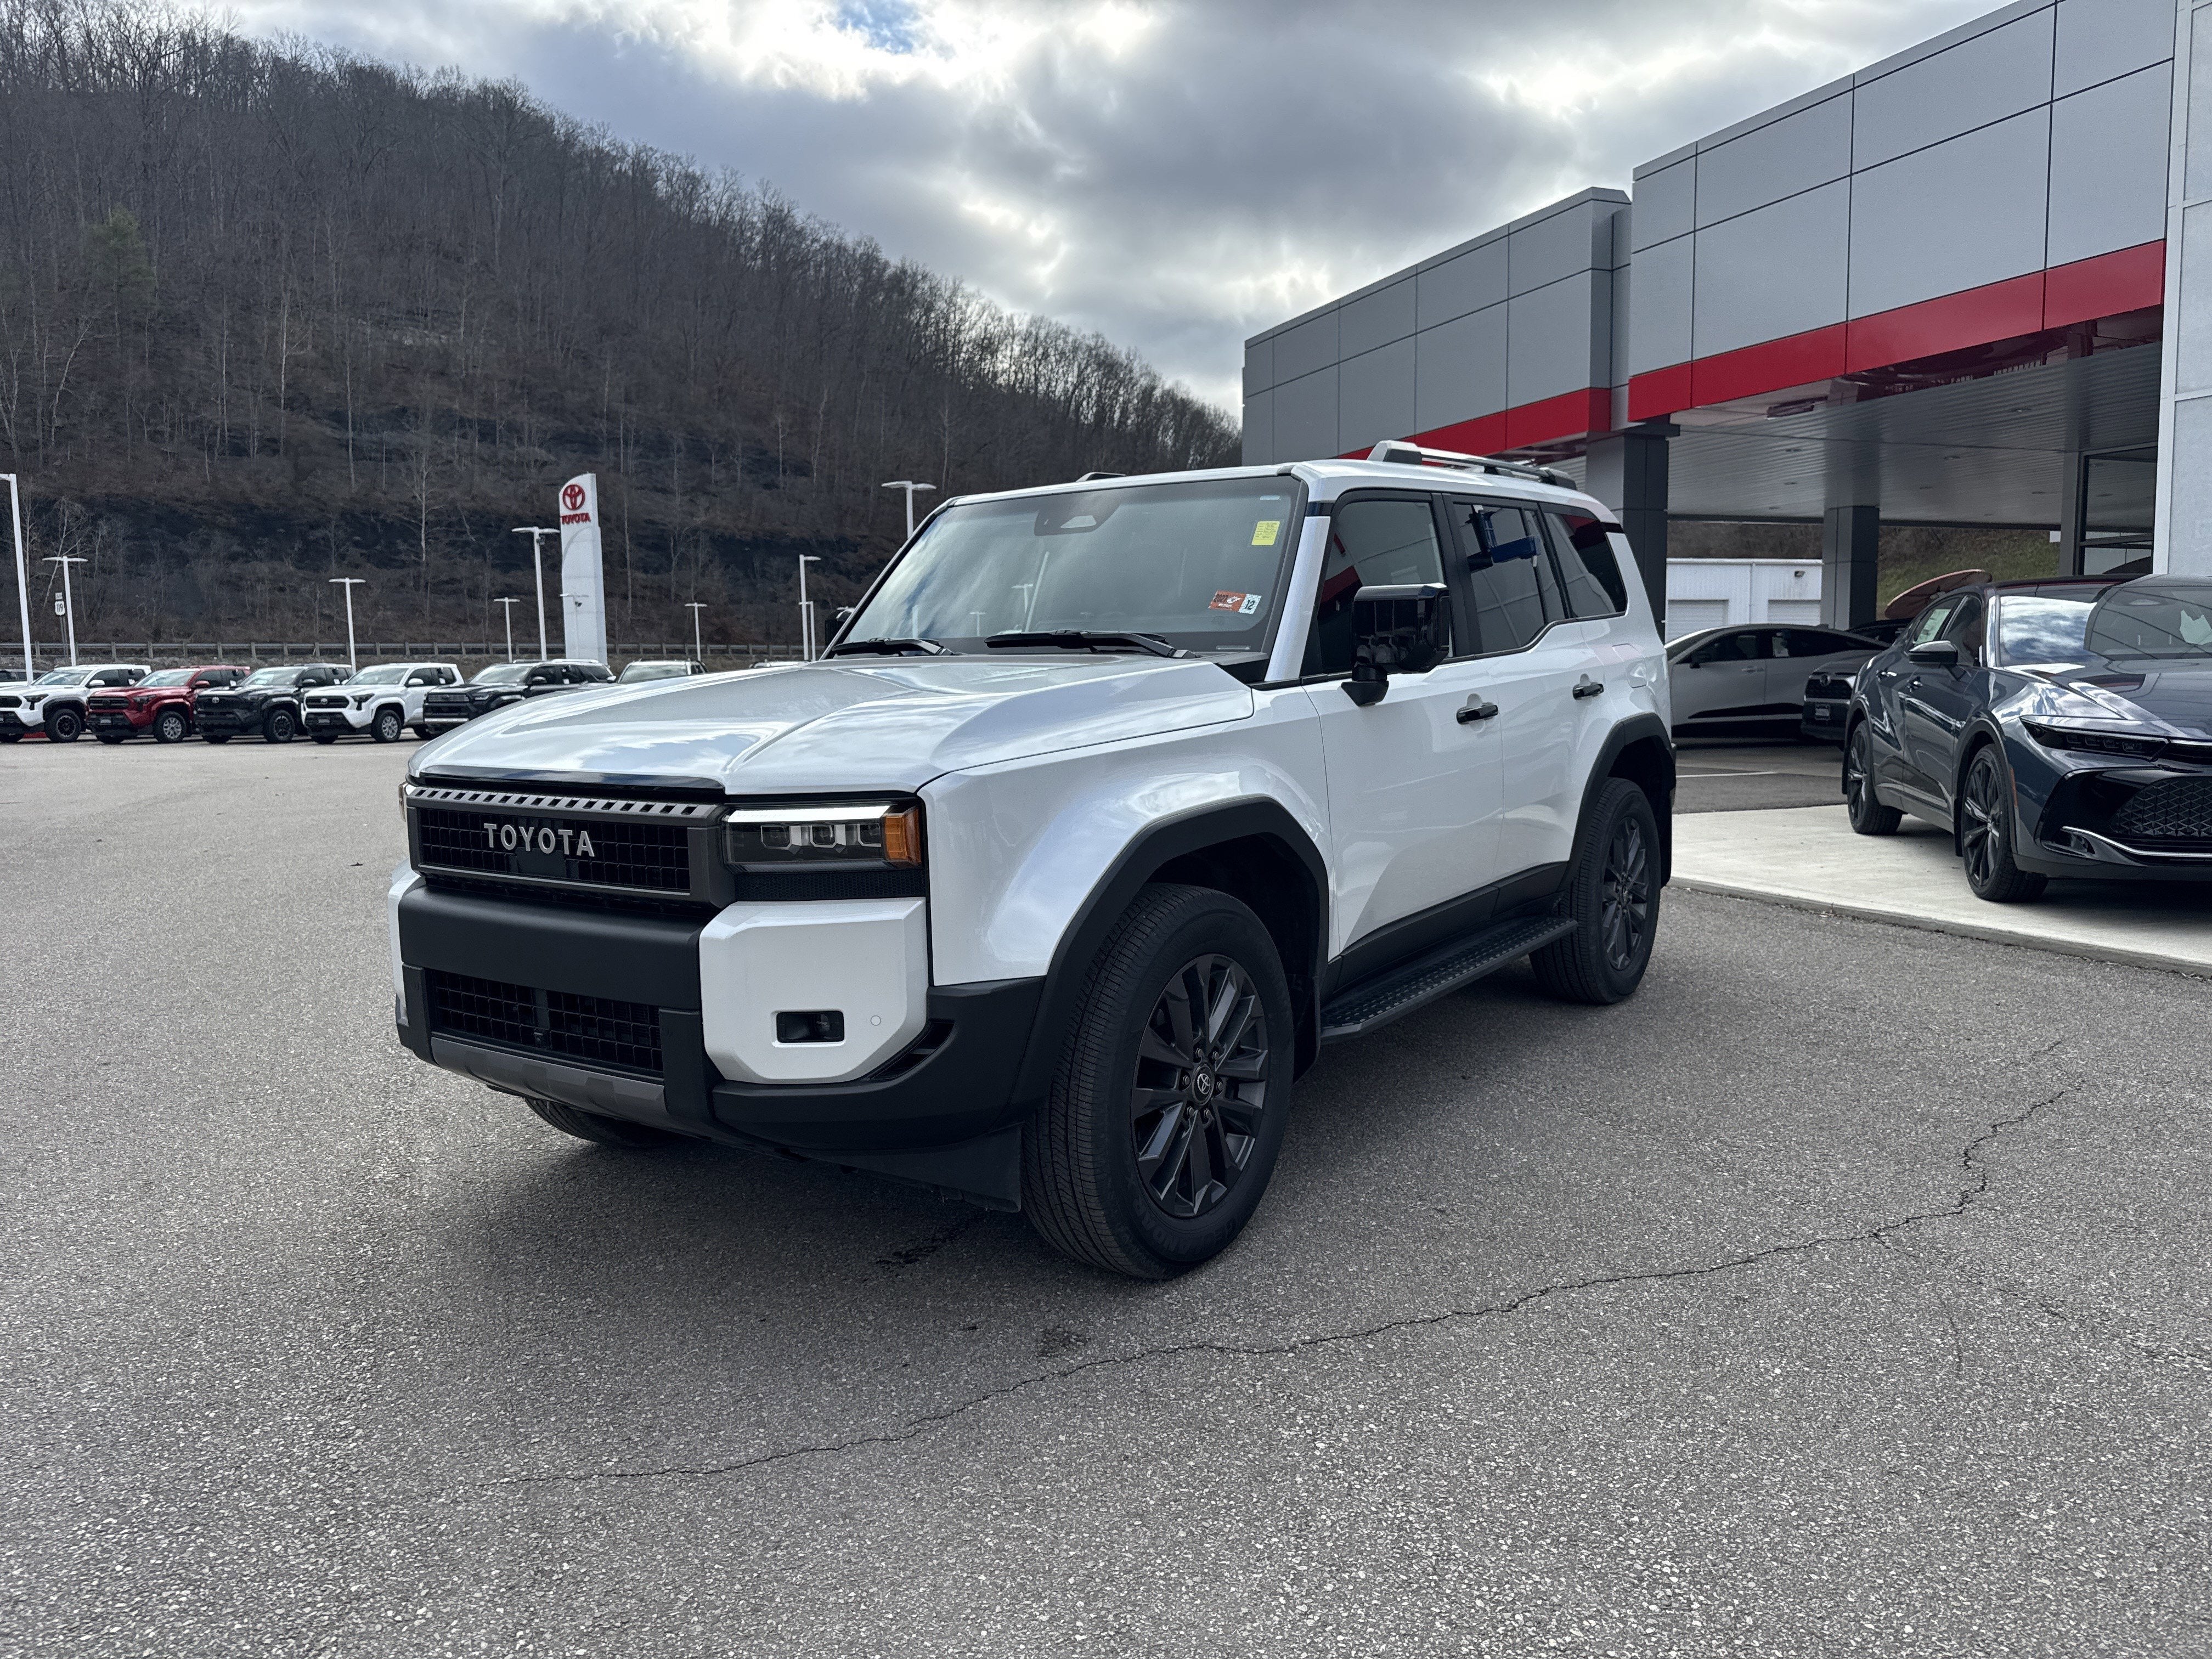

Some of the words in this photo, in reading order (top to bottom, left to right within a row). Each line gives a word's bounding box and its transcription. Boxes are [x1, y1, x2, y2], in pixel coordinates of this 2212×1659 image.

[561, 512, 591, 524] TOYOTA
[1213, 594, 1229, 603] 2027
[1244, 600, 1255, 610] 12
[483, 823, 595, 857] TOYOTA
